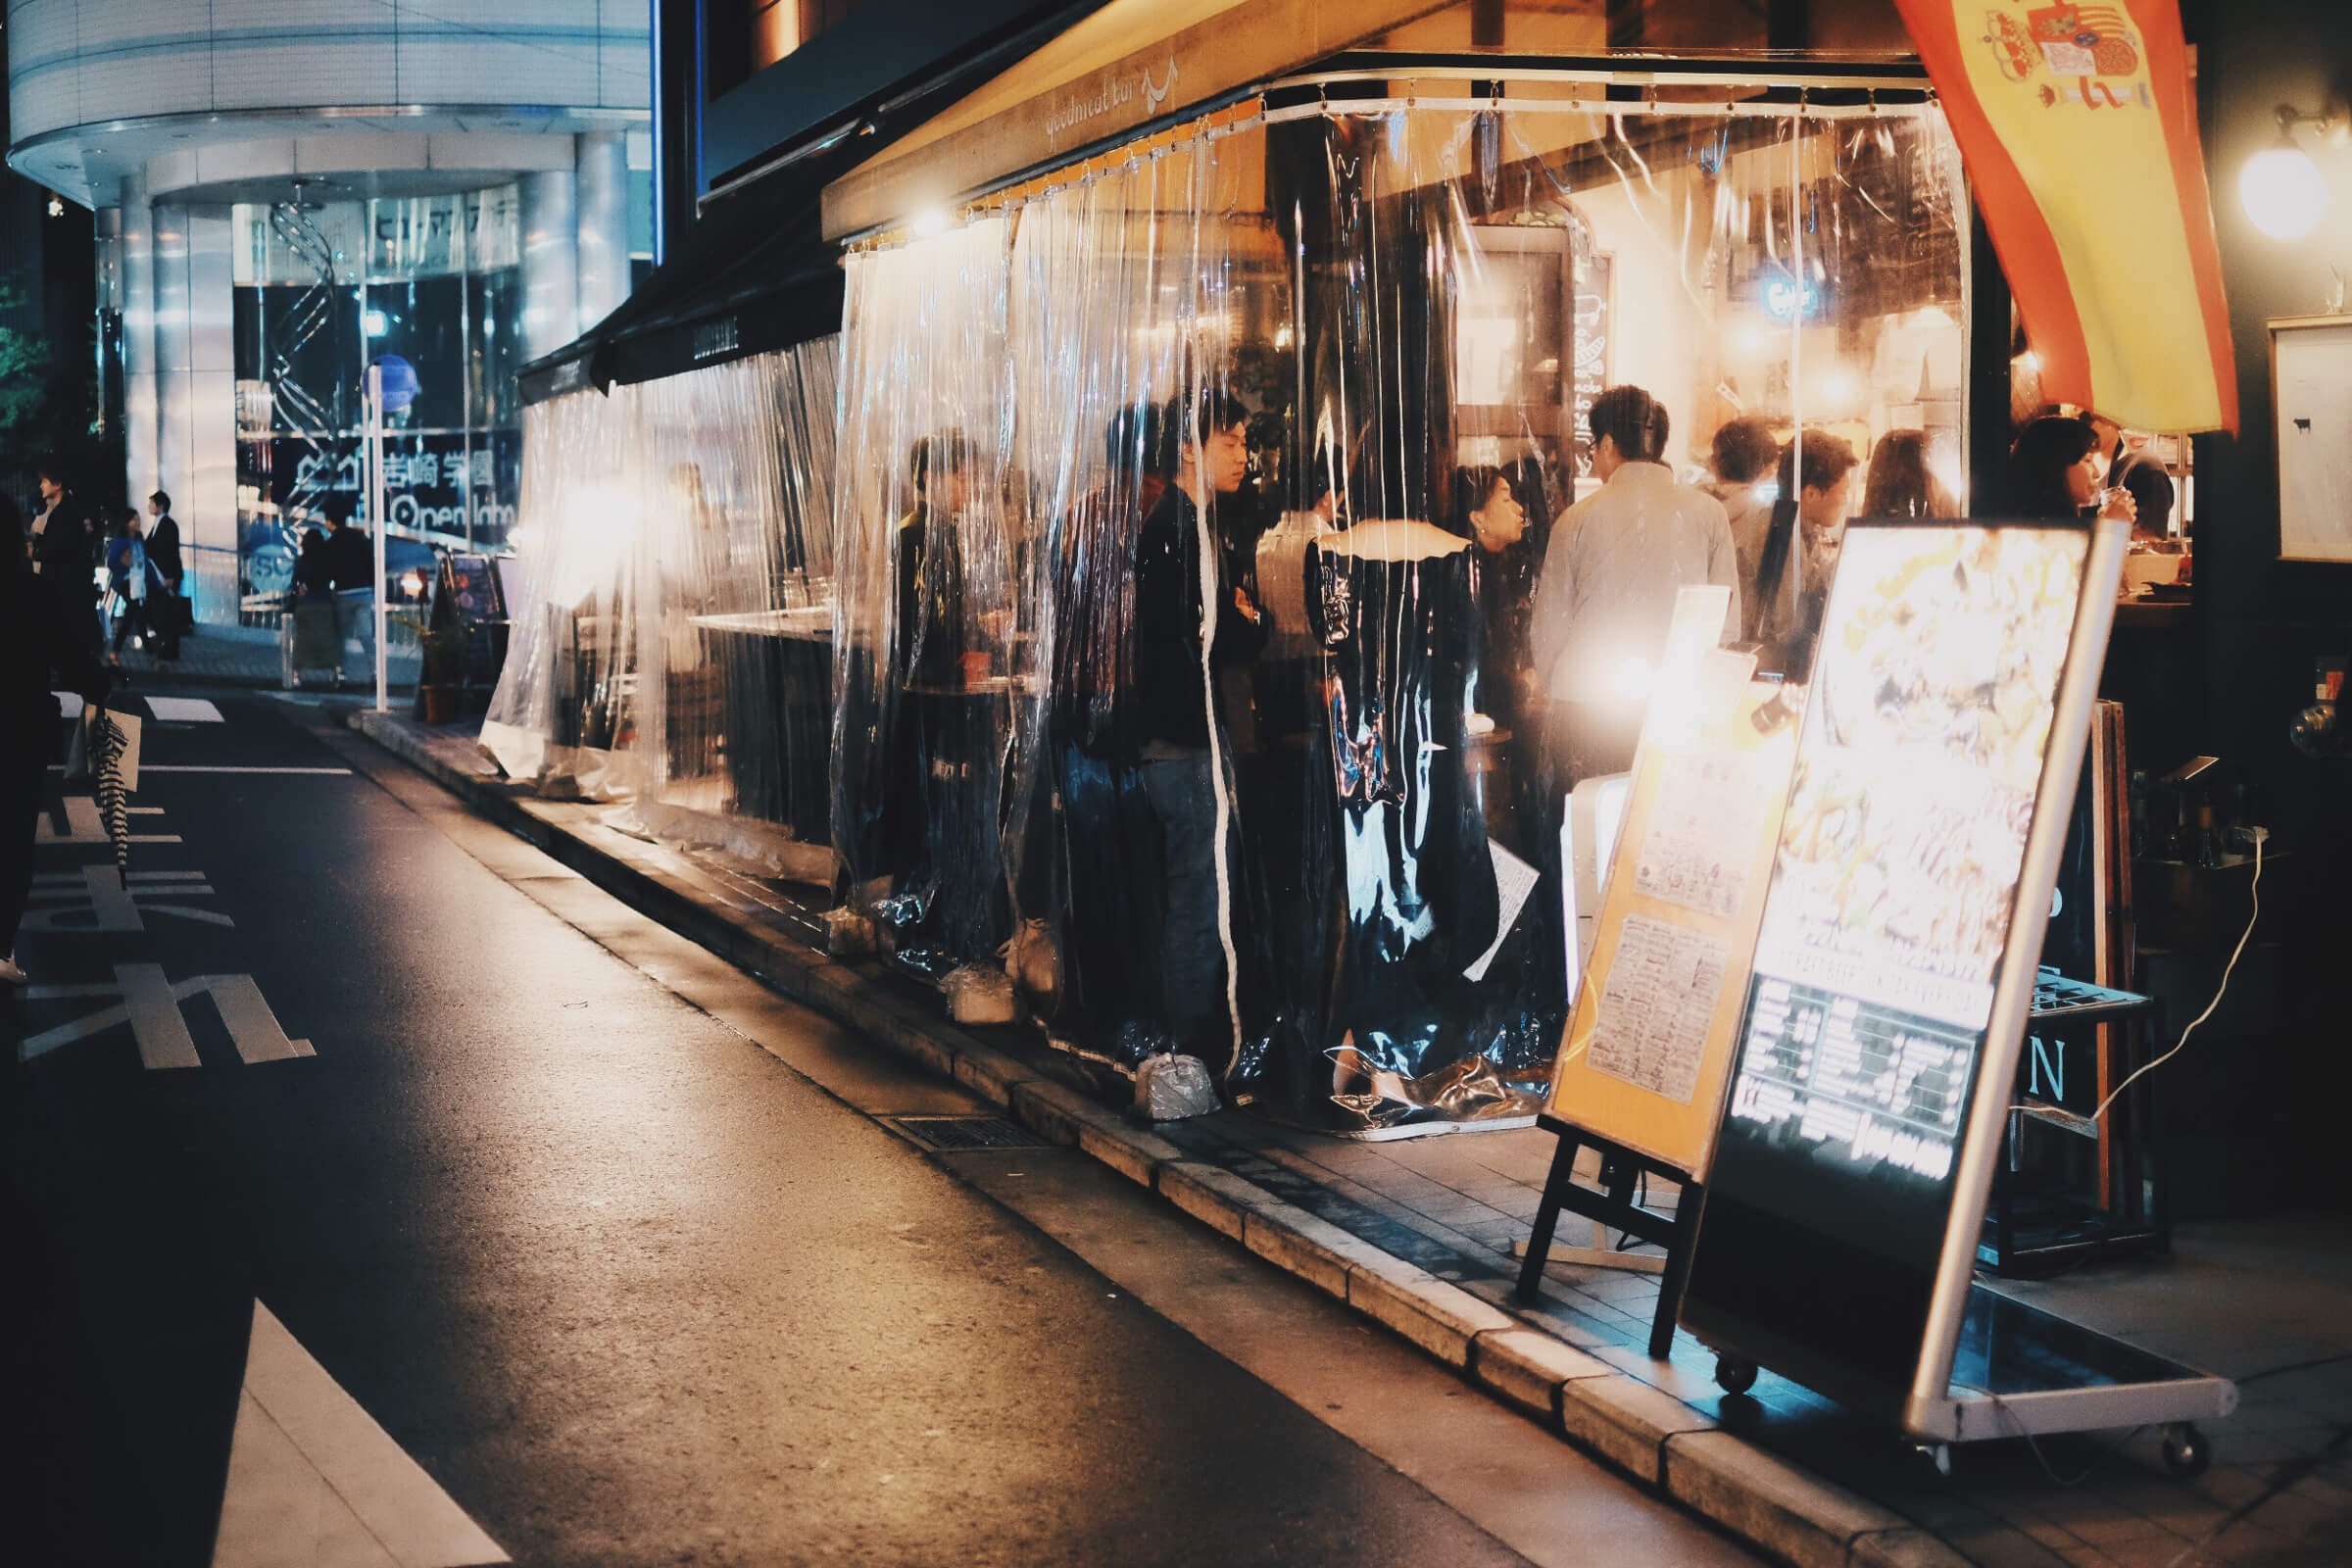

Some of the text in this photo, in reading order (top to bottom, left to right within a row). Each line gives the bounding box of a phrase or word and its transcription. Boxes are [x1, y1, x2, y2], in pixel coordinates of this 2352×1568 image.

[1045, 74, 1111, 154] goodmeat
[382, 449, 495, 489] 岩崎学園
